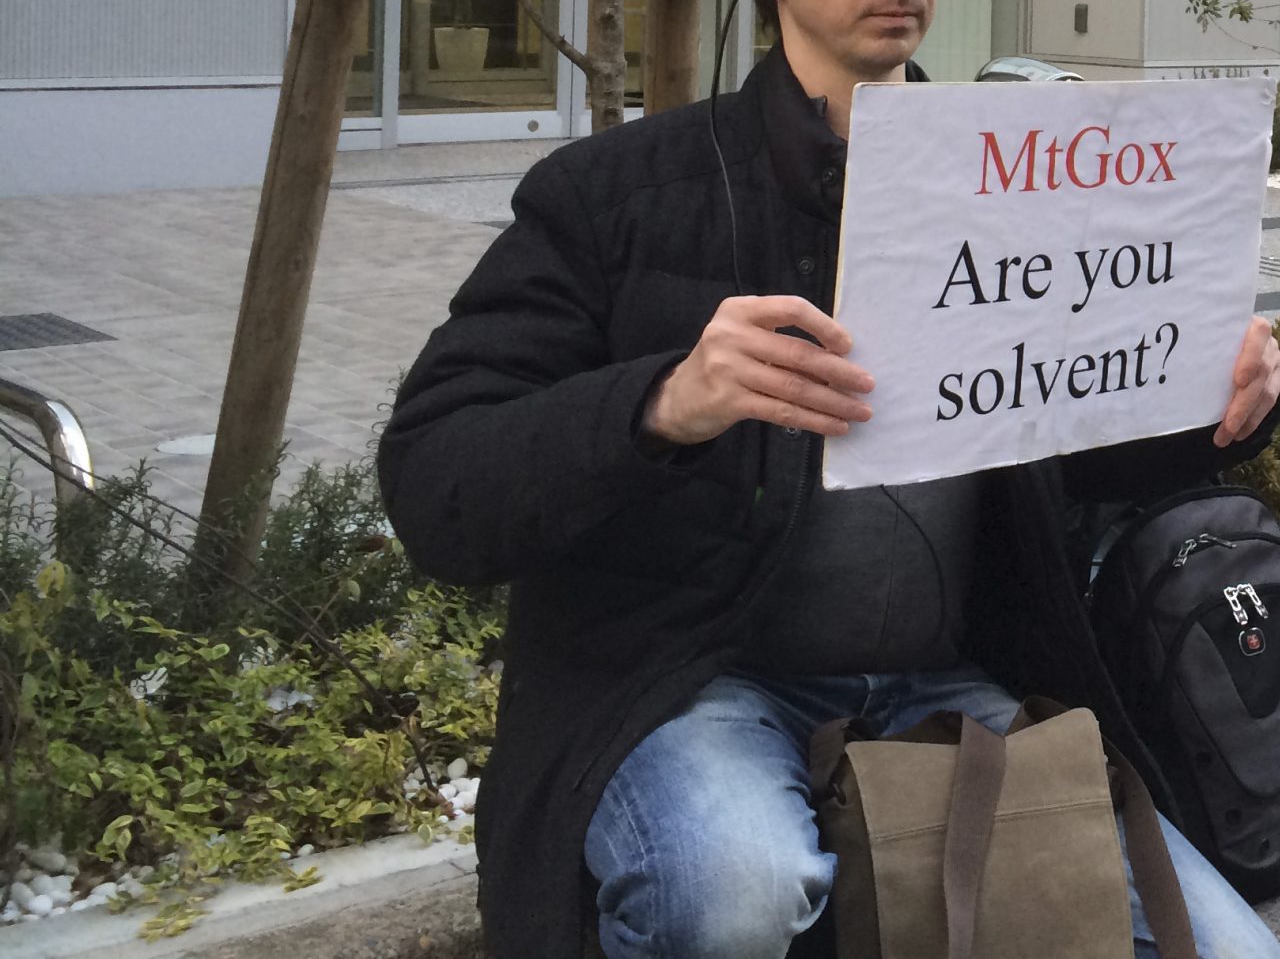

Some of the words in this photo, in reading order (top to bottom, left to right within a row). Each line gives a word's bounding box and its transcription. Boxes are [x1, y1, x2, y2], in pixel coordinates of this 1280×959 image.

[974, 124, 1179, 195] MtGox
[931, 240, 1053, 309] Are
[1071, 241, 1175, 313] you
[936, 322, 1180, 422] solvent?
